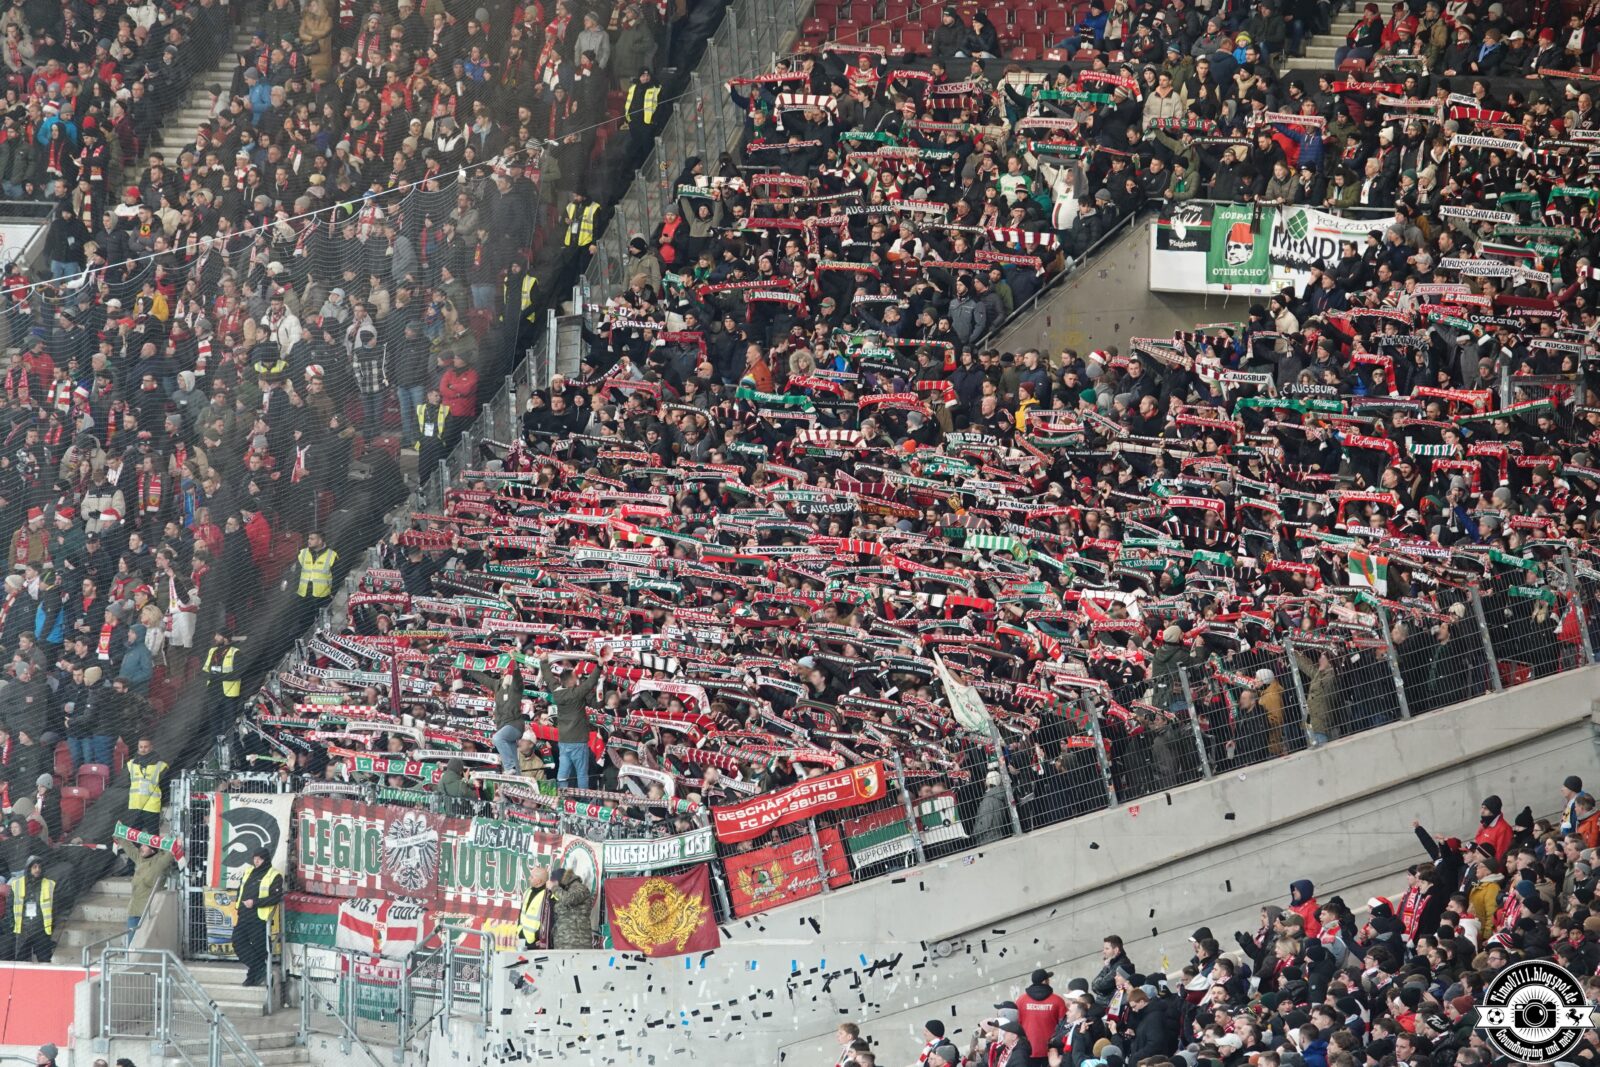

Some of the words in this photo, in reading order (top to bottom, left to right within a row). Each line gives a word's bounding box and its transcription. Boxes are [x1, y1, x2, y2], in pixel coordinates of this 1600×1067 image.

[1457, 135, 1520, 150] NORDSCHWABEN
[1444, 206, 1511, 221] NORDSCHWABEN
[985, 253, 1034, 263] AUGSBURG
[754, 291, 802, 303] AUGSBURG
[1457, 294, 1492, 306] AUGSBUR
[1545, 342, 1580, 353] AUGSBUR
[1233, 374, 1267, 383] AUGSBUR
[773, 493, 791, 501] NUR
[793, 493, 809, 501] DER
[811, 494, 827, 503] FCA
[796, 505, 808, 515] FC
[676, 608, 720, 621] AUGSBU
[457, 698, 485, 707] KICKERS
[858, 768, 874, 777] FCA
[230, 794, 274, 806] Augusta
[739, 817, 758, 830] FC
[300, 817, 381, 875] LEGIO
[605, 839, 681, 865] AUGSBURG
[685, 832, 713, 857] OST
[792, 850, 818, 865] Bell
[857, 842, 903, 863] SUPPORTER
[438, 841, 562, 893] AUGUST
[788, 867, 837, 891] Augua
[388, 905, 418, 920] FOOLS
[210, 944, 233, 954] CAL
[1026, 1003, 1054, 1011] SECURITY
